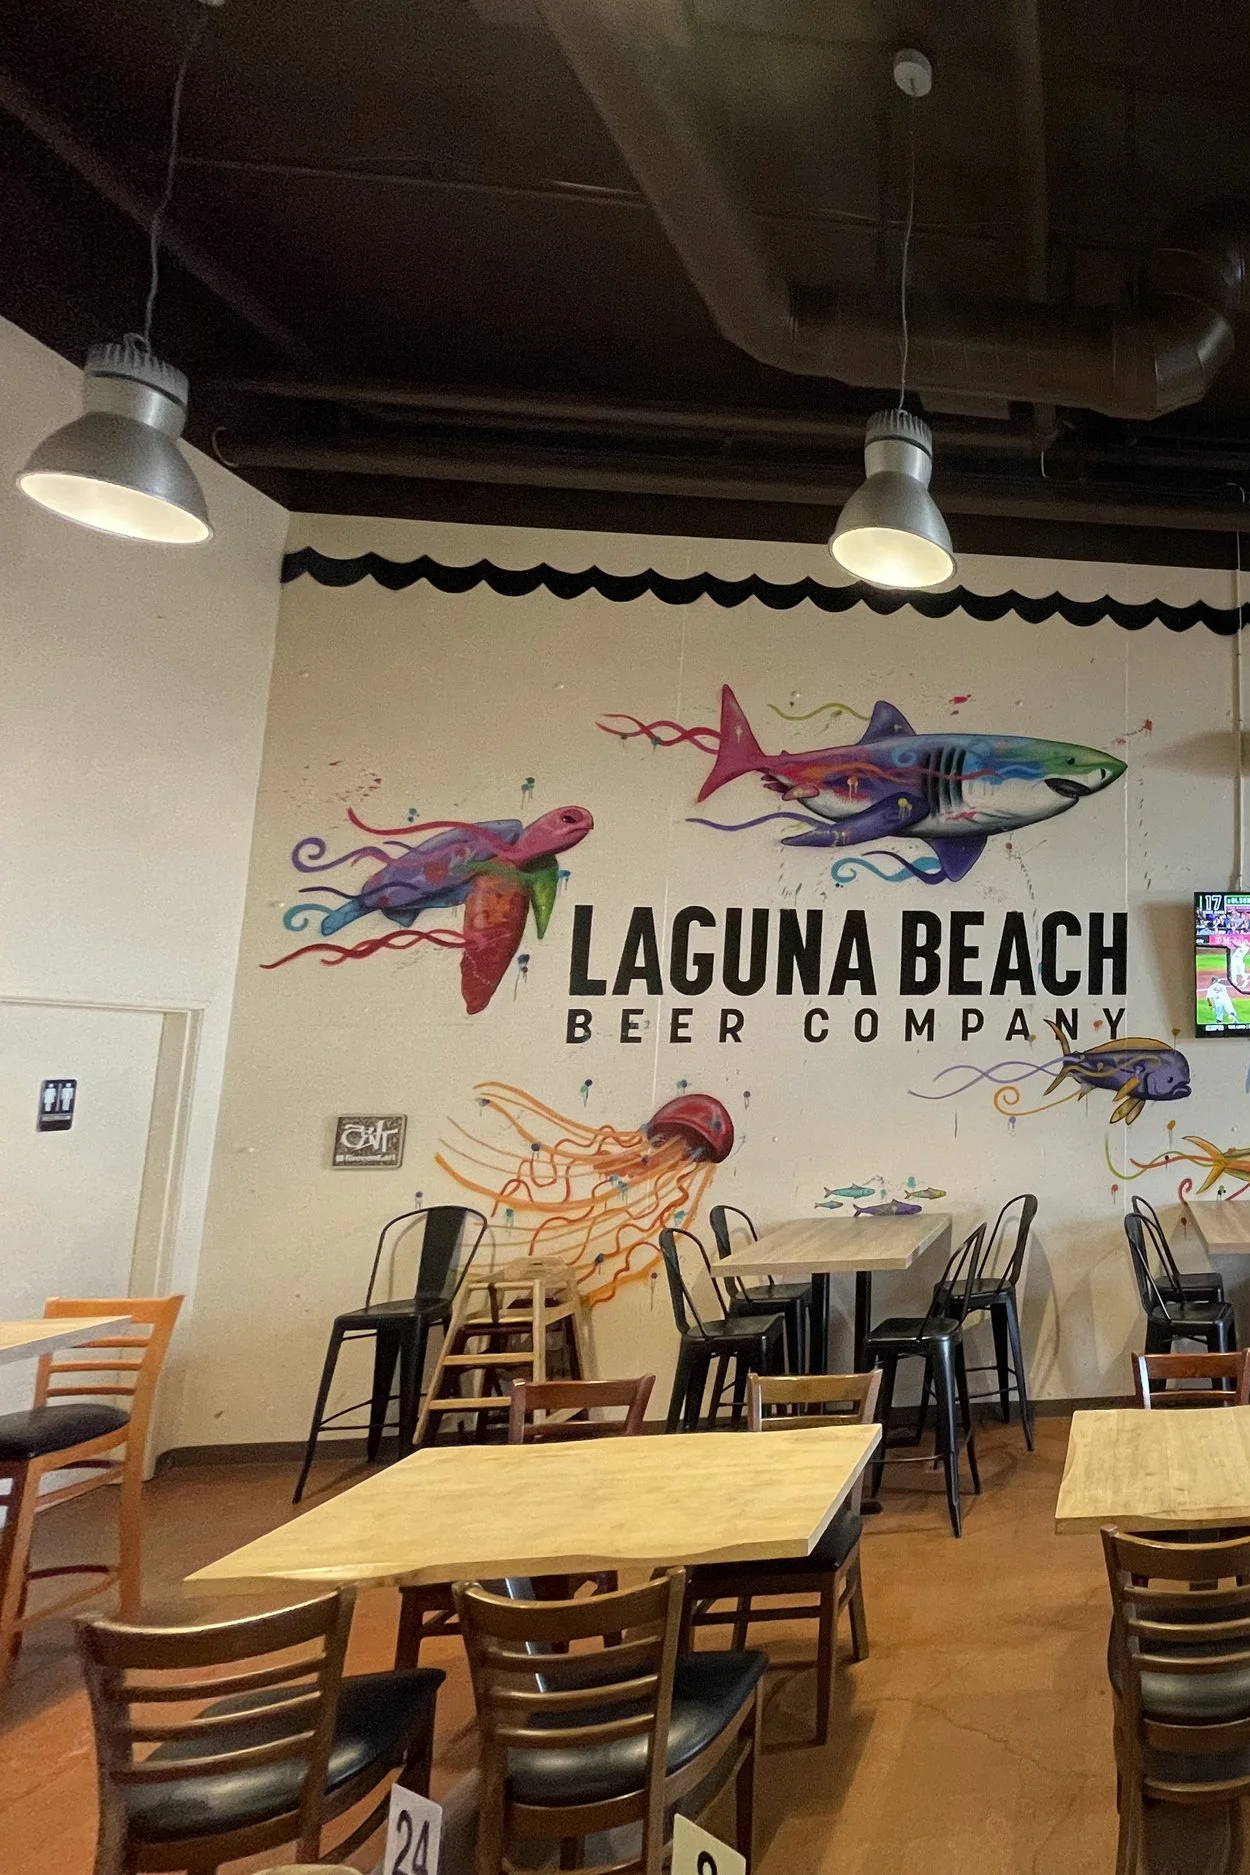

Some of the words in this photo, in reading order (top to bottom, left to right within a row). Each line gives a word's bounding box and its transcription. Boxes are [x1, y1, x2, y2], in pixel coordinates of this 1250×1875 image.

[1204, 894, 1222, 911] 17
[569, 904, 877, 996] LAGUNA
[899, 910, 1128, 996] BEACH
[566, 1008, 744, 1043] BEER
[803, 1008, 1125, 1043] COMPANY
[392, 1809, 429, 1875] 24
